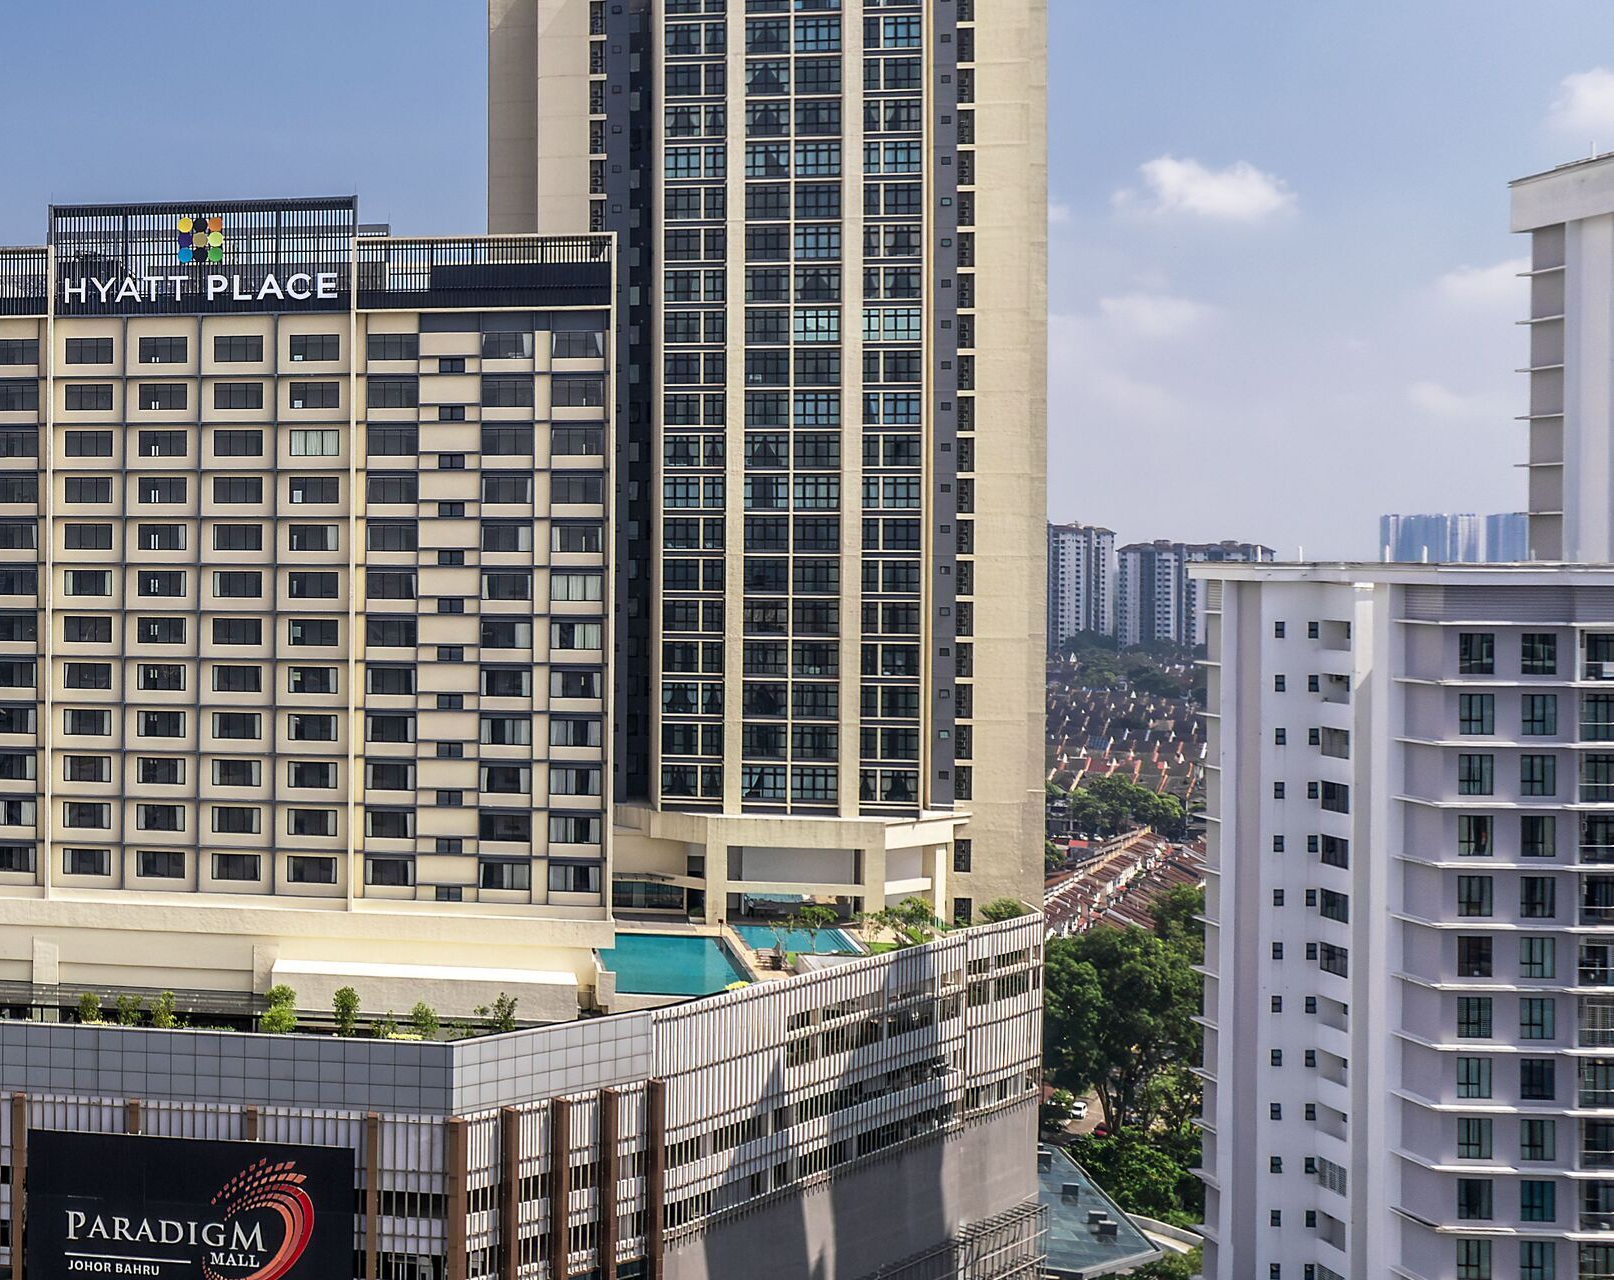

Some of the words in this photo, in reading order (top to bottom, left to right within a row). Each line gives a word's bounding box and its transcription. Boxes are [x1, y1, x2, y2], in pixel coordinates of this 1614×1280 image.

[64, 276, 189, 303] HYATT
[207, 273, 339, 301] PLACE
[65, 1209, 268, 1253] PARADIGM
[68, 1259, 111, 1273] JOHOR
[115, 1263, 160, 1276] BAHRU
[210, 1252, 260, 1268] MALL
